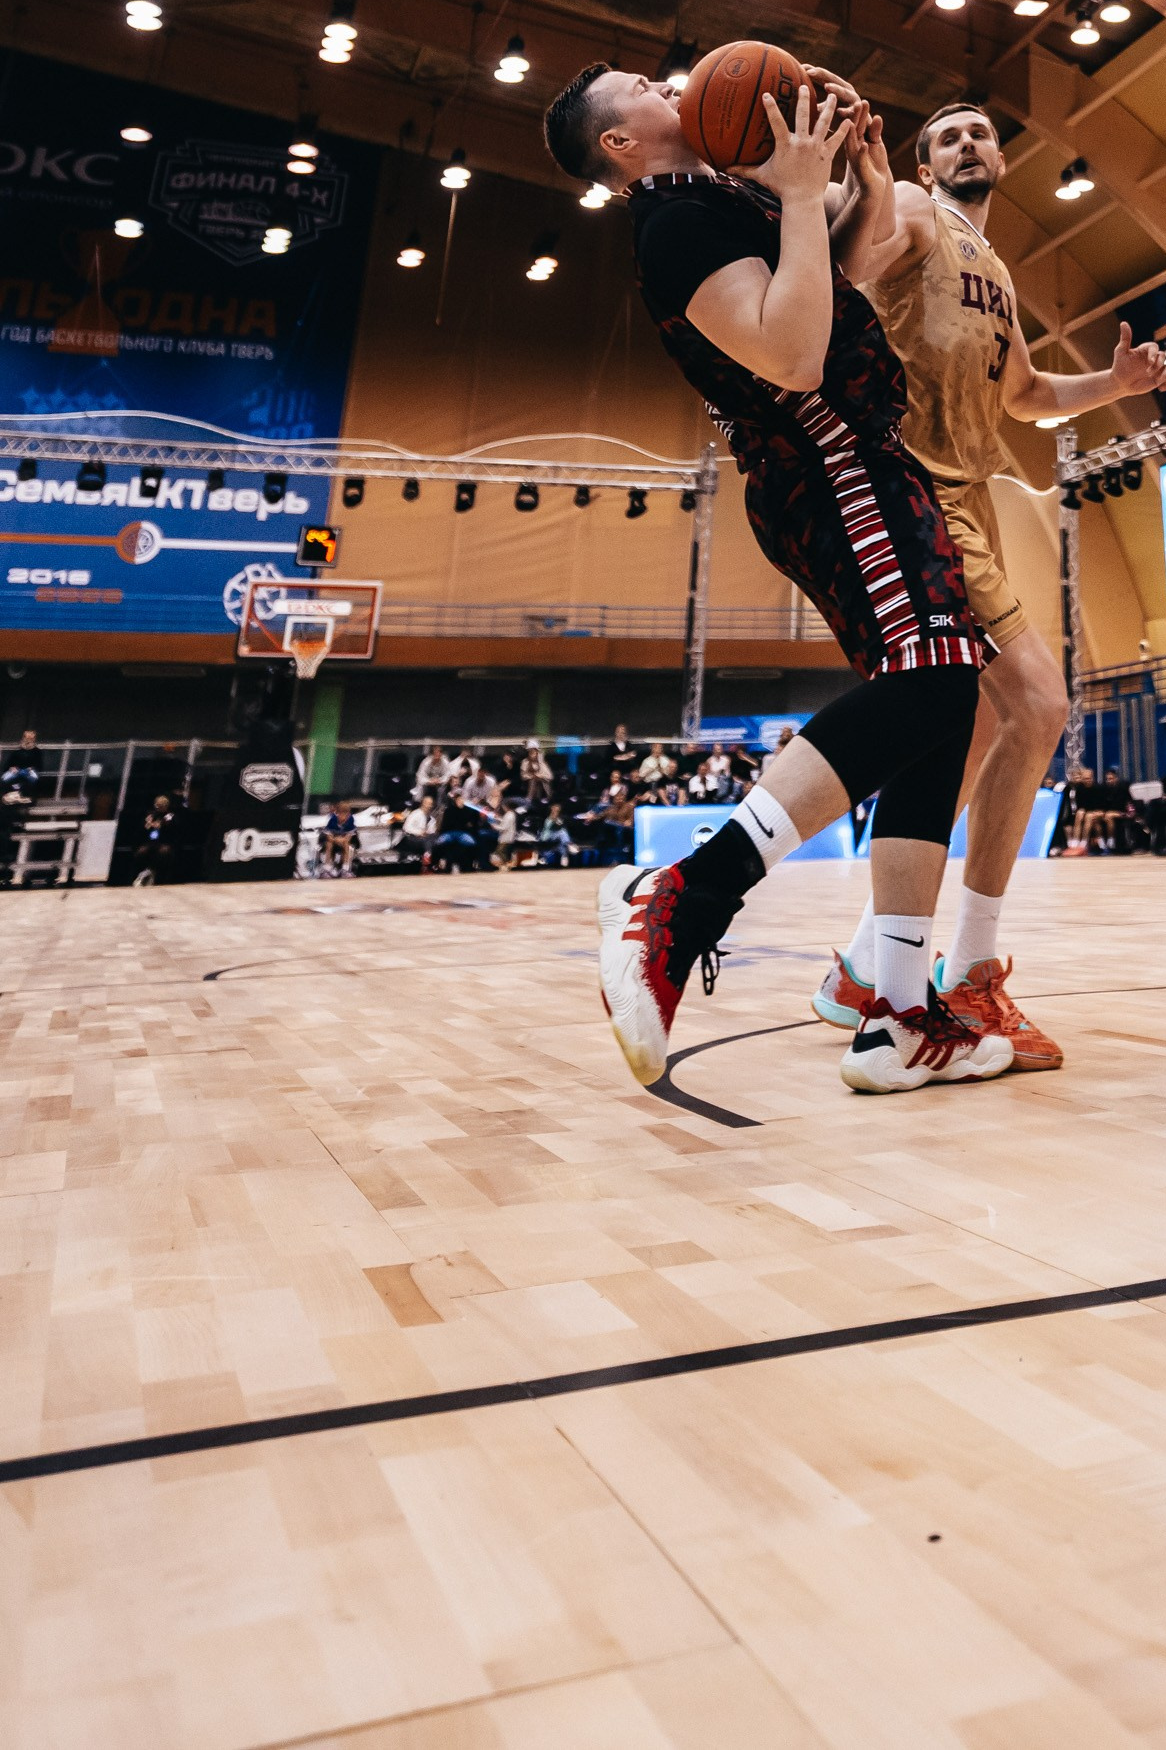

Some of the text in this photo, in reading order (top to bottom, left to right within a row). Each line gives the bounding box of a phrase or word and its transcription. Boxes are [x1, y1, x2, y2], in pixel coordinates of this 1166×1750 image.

[171, 170, 277, 195] ФИНАЛ
[0, 325, 31, 343] ГОД
[177, 338, 226, 358] КЛУБА
[230, 340, 275, 361] ТВЕРЬ
